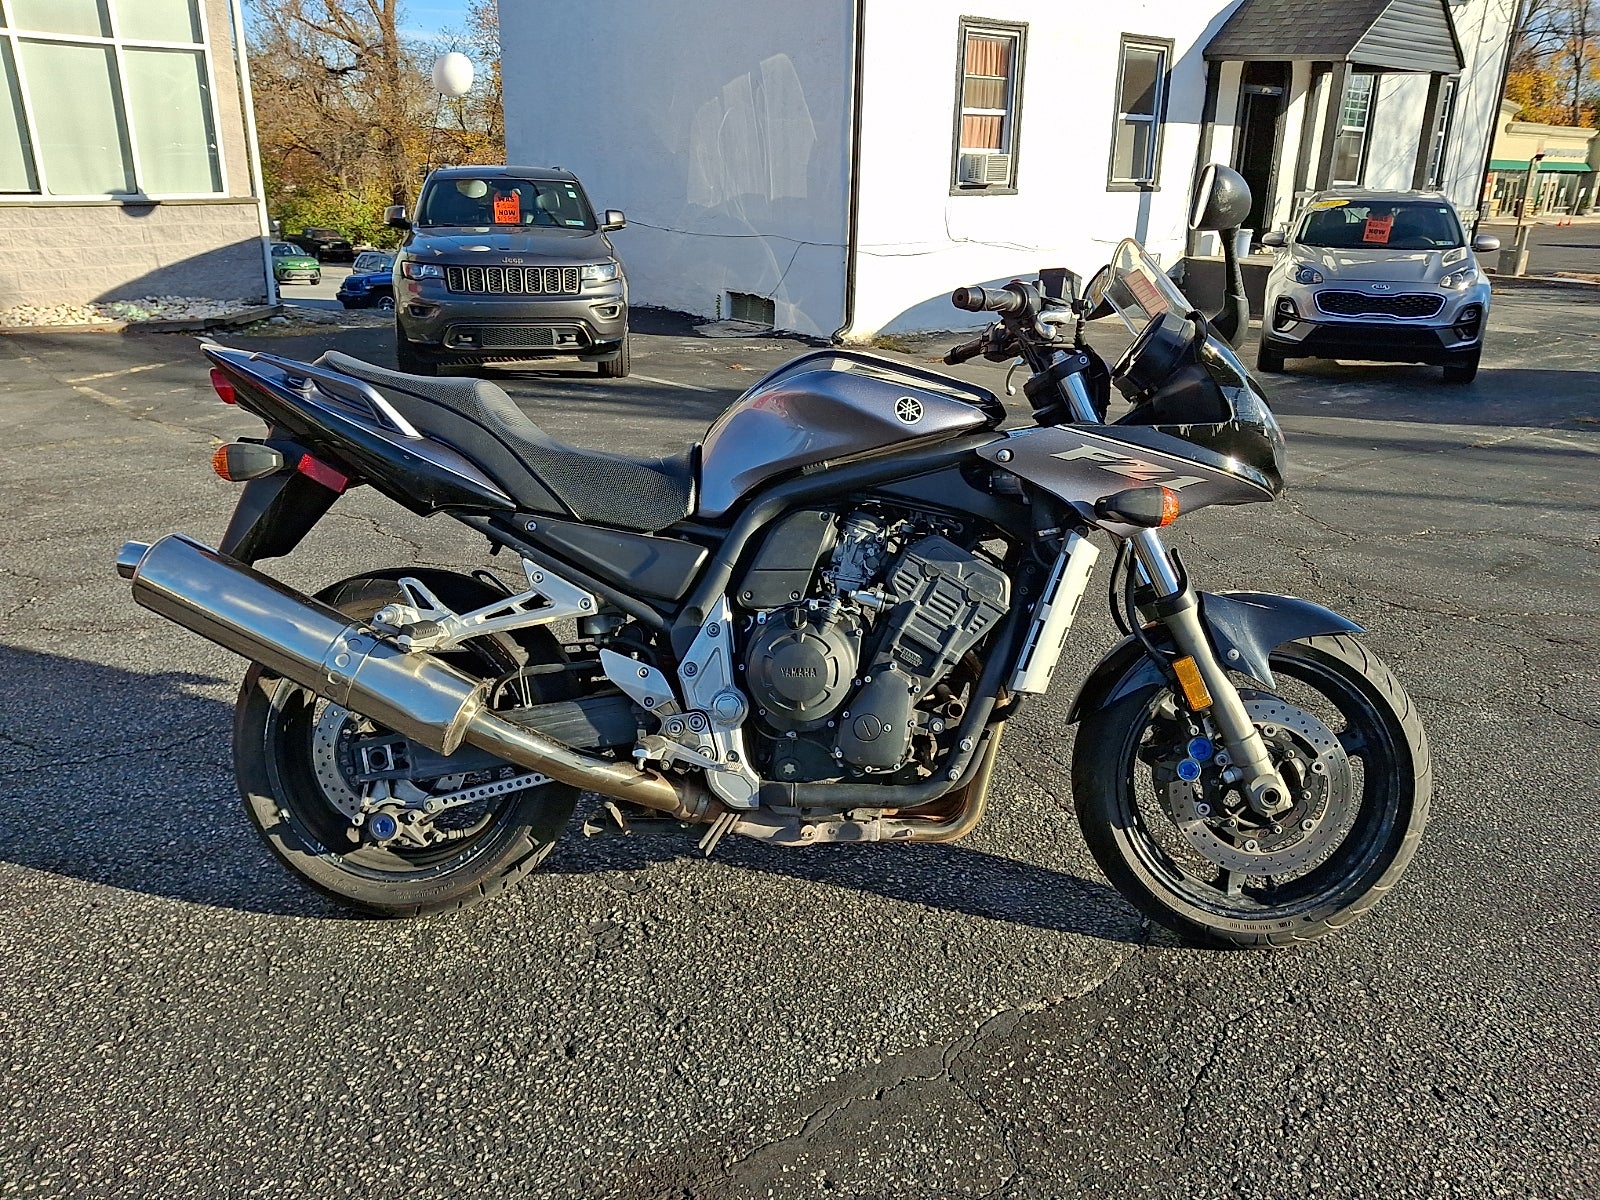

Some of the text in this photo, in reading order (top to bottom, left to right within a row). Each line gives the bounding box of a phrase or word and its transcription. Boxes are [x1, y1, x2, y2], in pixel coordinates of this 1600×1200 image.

[501, 256, 524, 265] Jeep
[1050, 443, 1209, 492] FZ1
[780, 667, 817, 678] YAMAHA
